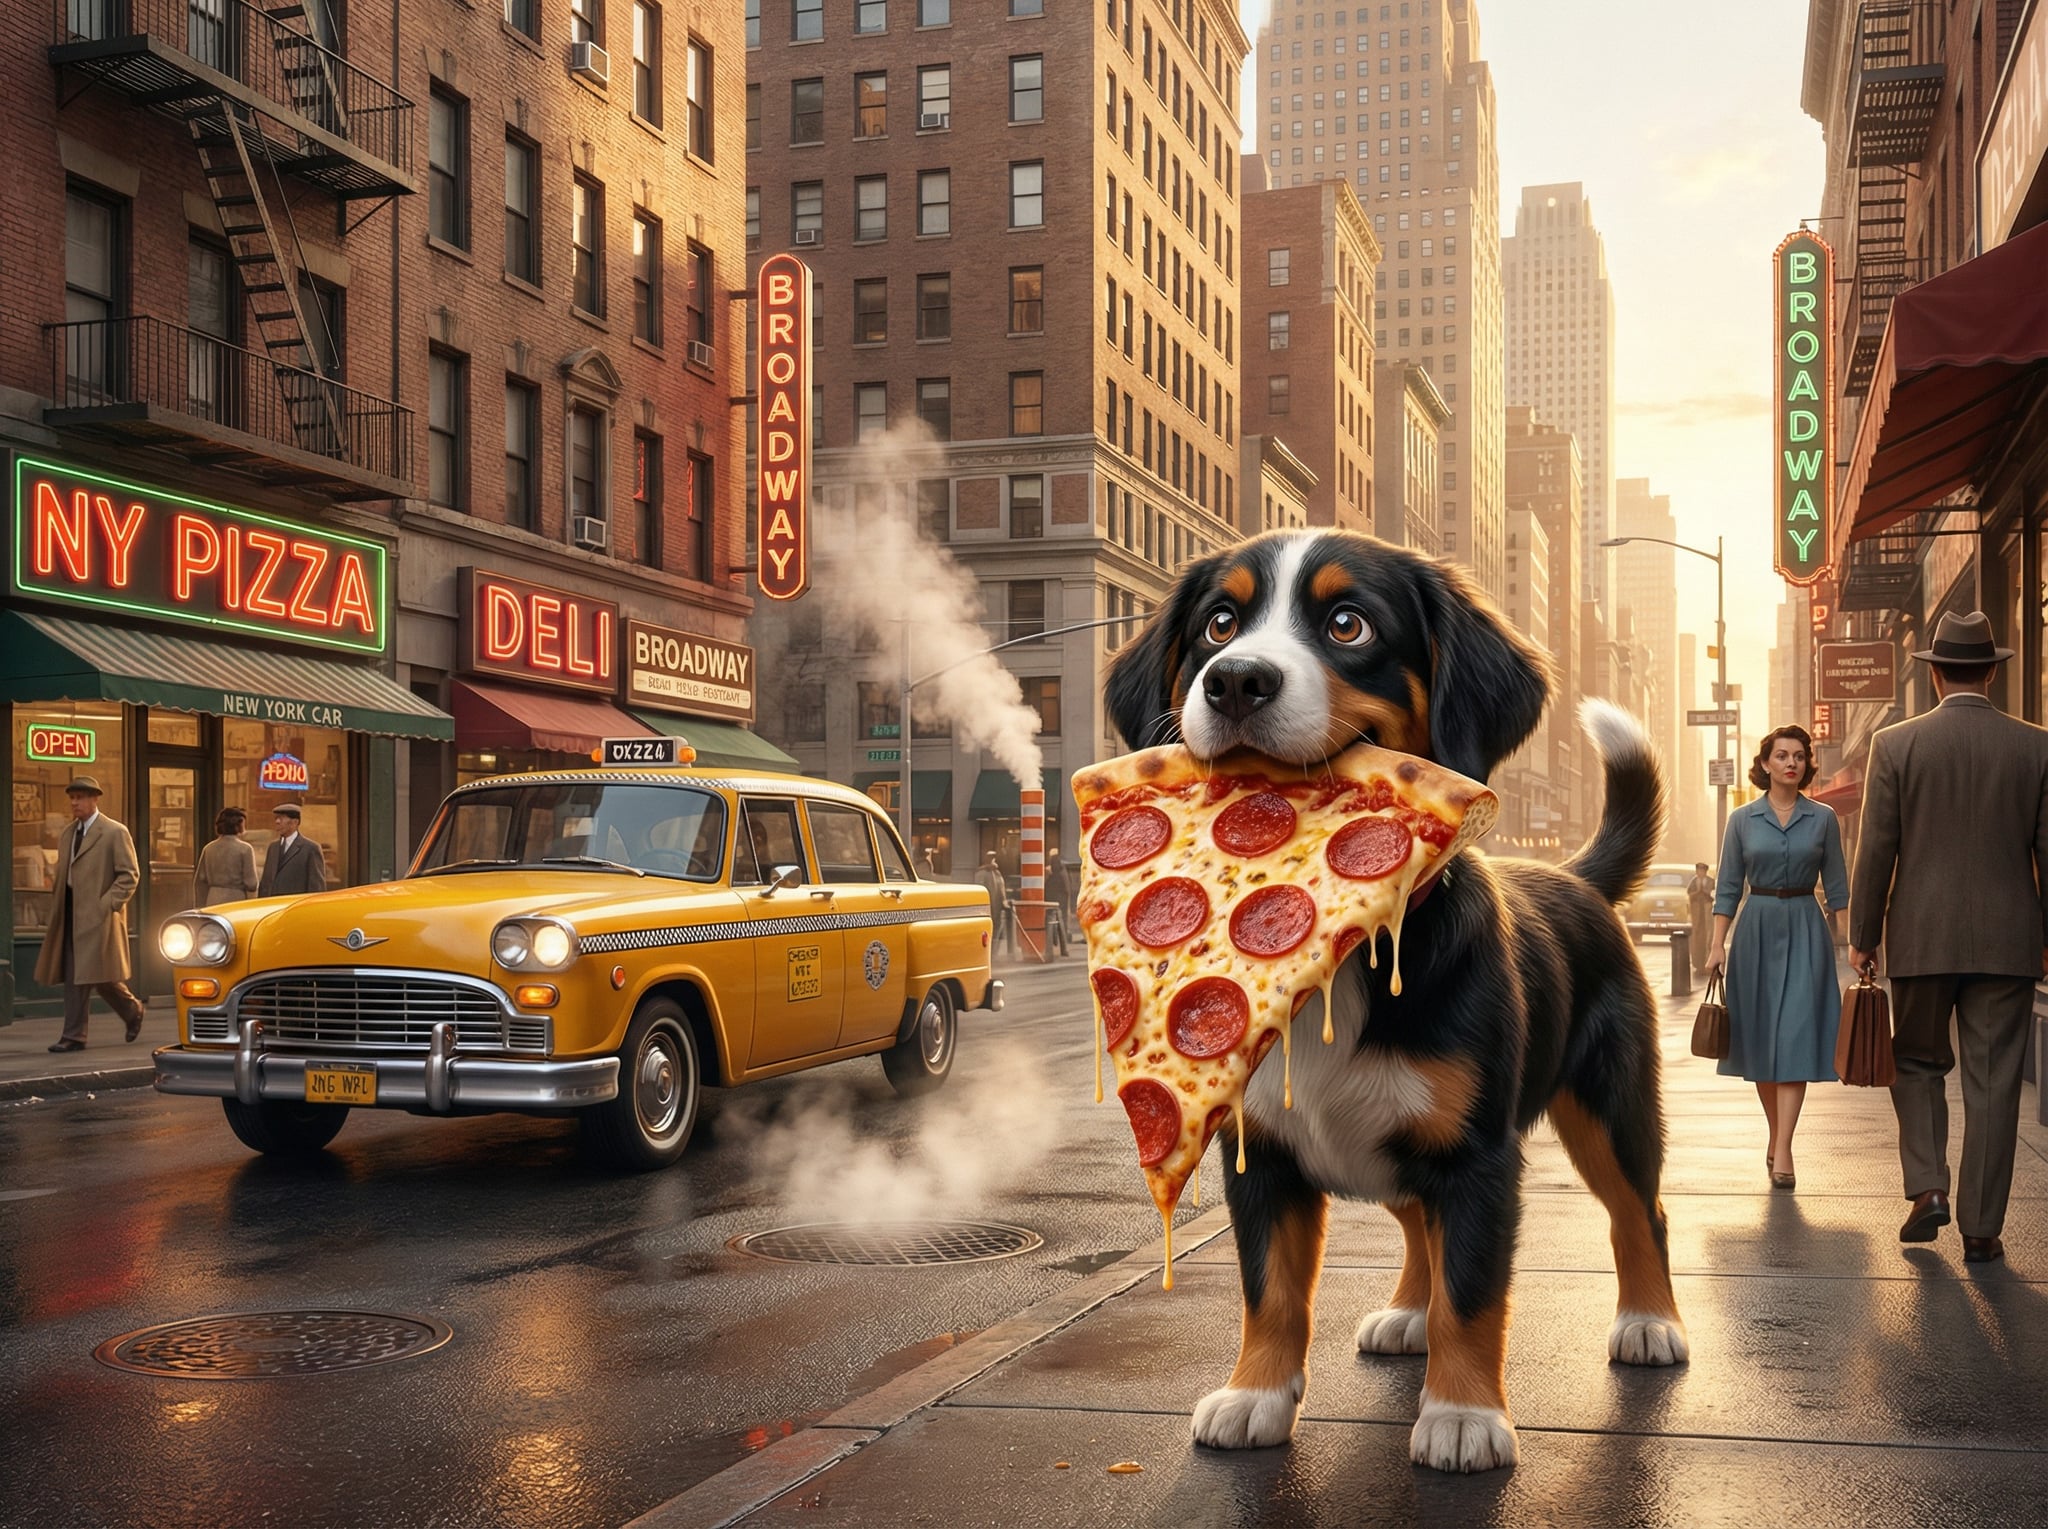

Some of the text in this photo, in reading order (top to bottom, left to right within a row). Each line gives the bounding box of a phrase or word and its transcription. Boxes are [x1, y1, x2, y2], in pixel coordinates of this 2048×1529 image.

[764, 274, 798, 581] BROADWAY
[1783, 251, 1823, 563] BROADWAY
[35, 481, 375, 633] NY PIZZA
[485, 583, 610, 679] DELI
[635, 631, 749, 685] BROADWAY
[32, 731, 89, 756] OPEN
[223, 694, 343, 726] NEW YORK CAR
